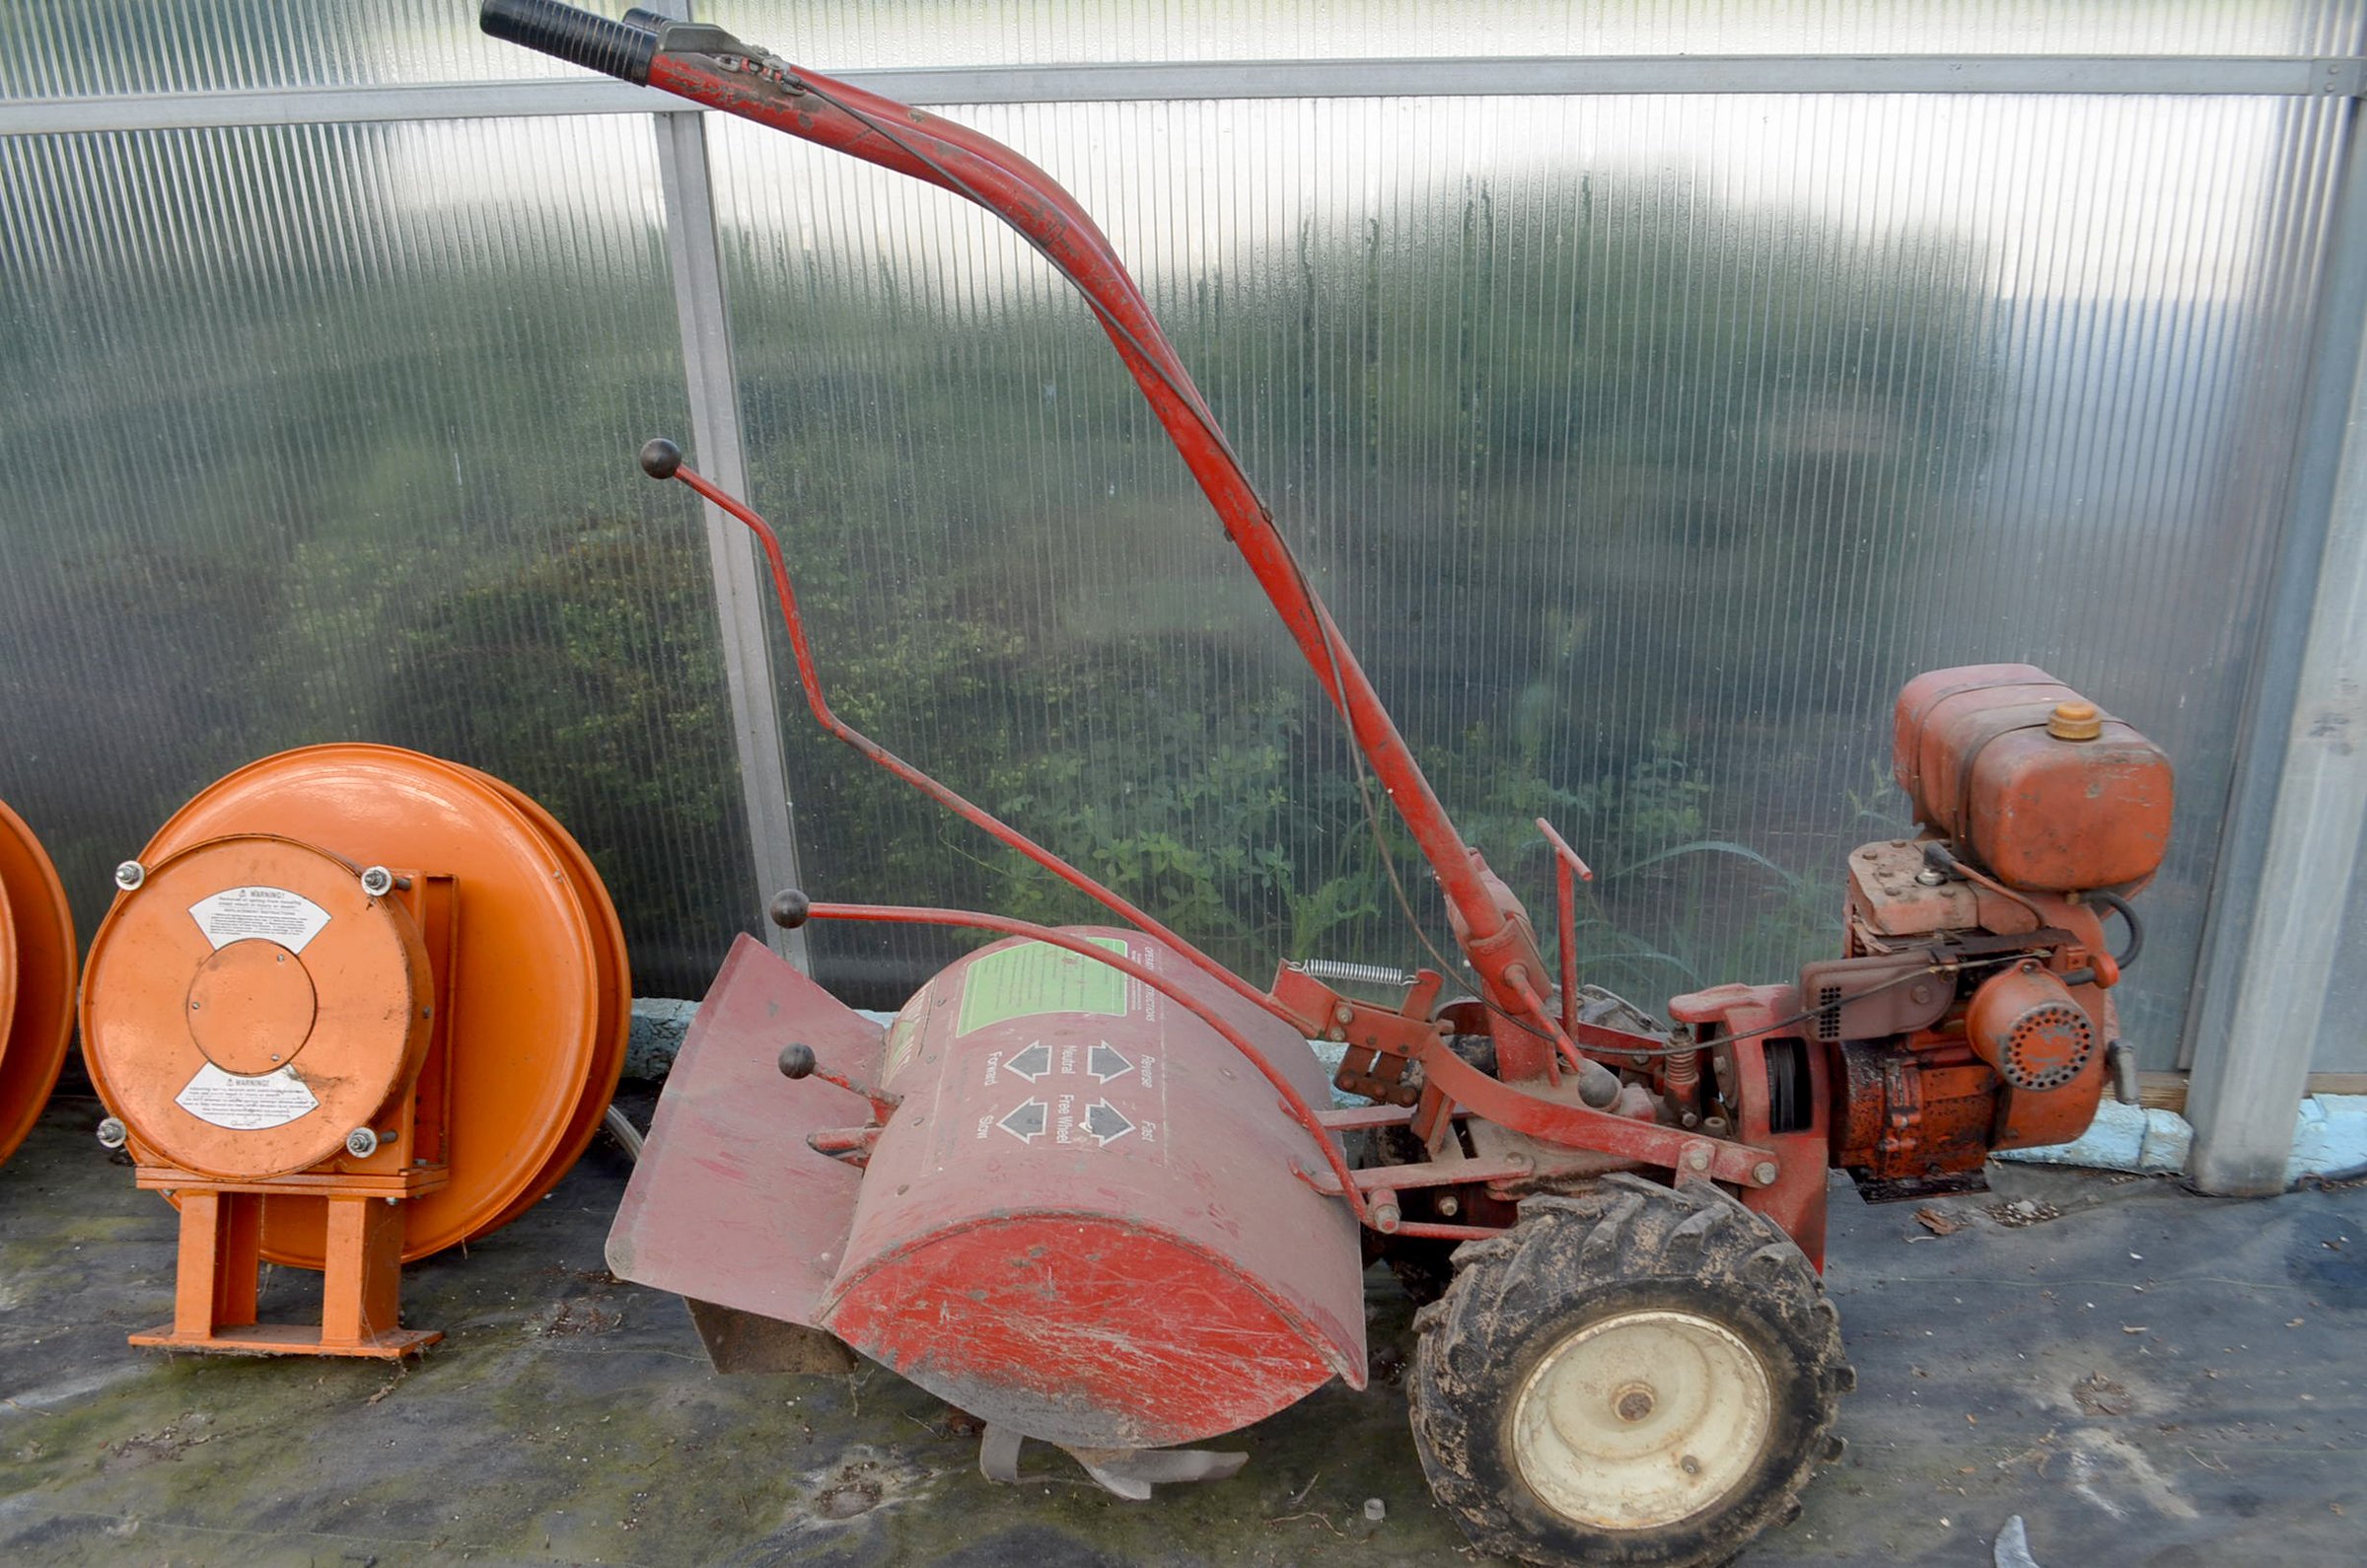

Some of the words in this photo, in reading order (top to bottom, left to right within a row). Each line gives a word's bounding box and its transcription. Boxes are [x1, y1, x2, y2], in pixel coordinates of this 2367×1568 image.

[251, 891, 285, 899] WARNING!
[984, 1051, 1002, 1086] Forward
[1060, 1045, 1077, 1074] Neutral
[1141, 1054, 1156, 1088] Reverse
[1057, 1094, 1075, 1114] Free
[976, 1115, 994, 1139] Slow
[1056, 1115, 1073, 1144] Wheel
[1141, 1120, 1156, 1142] Fast
